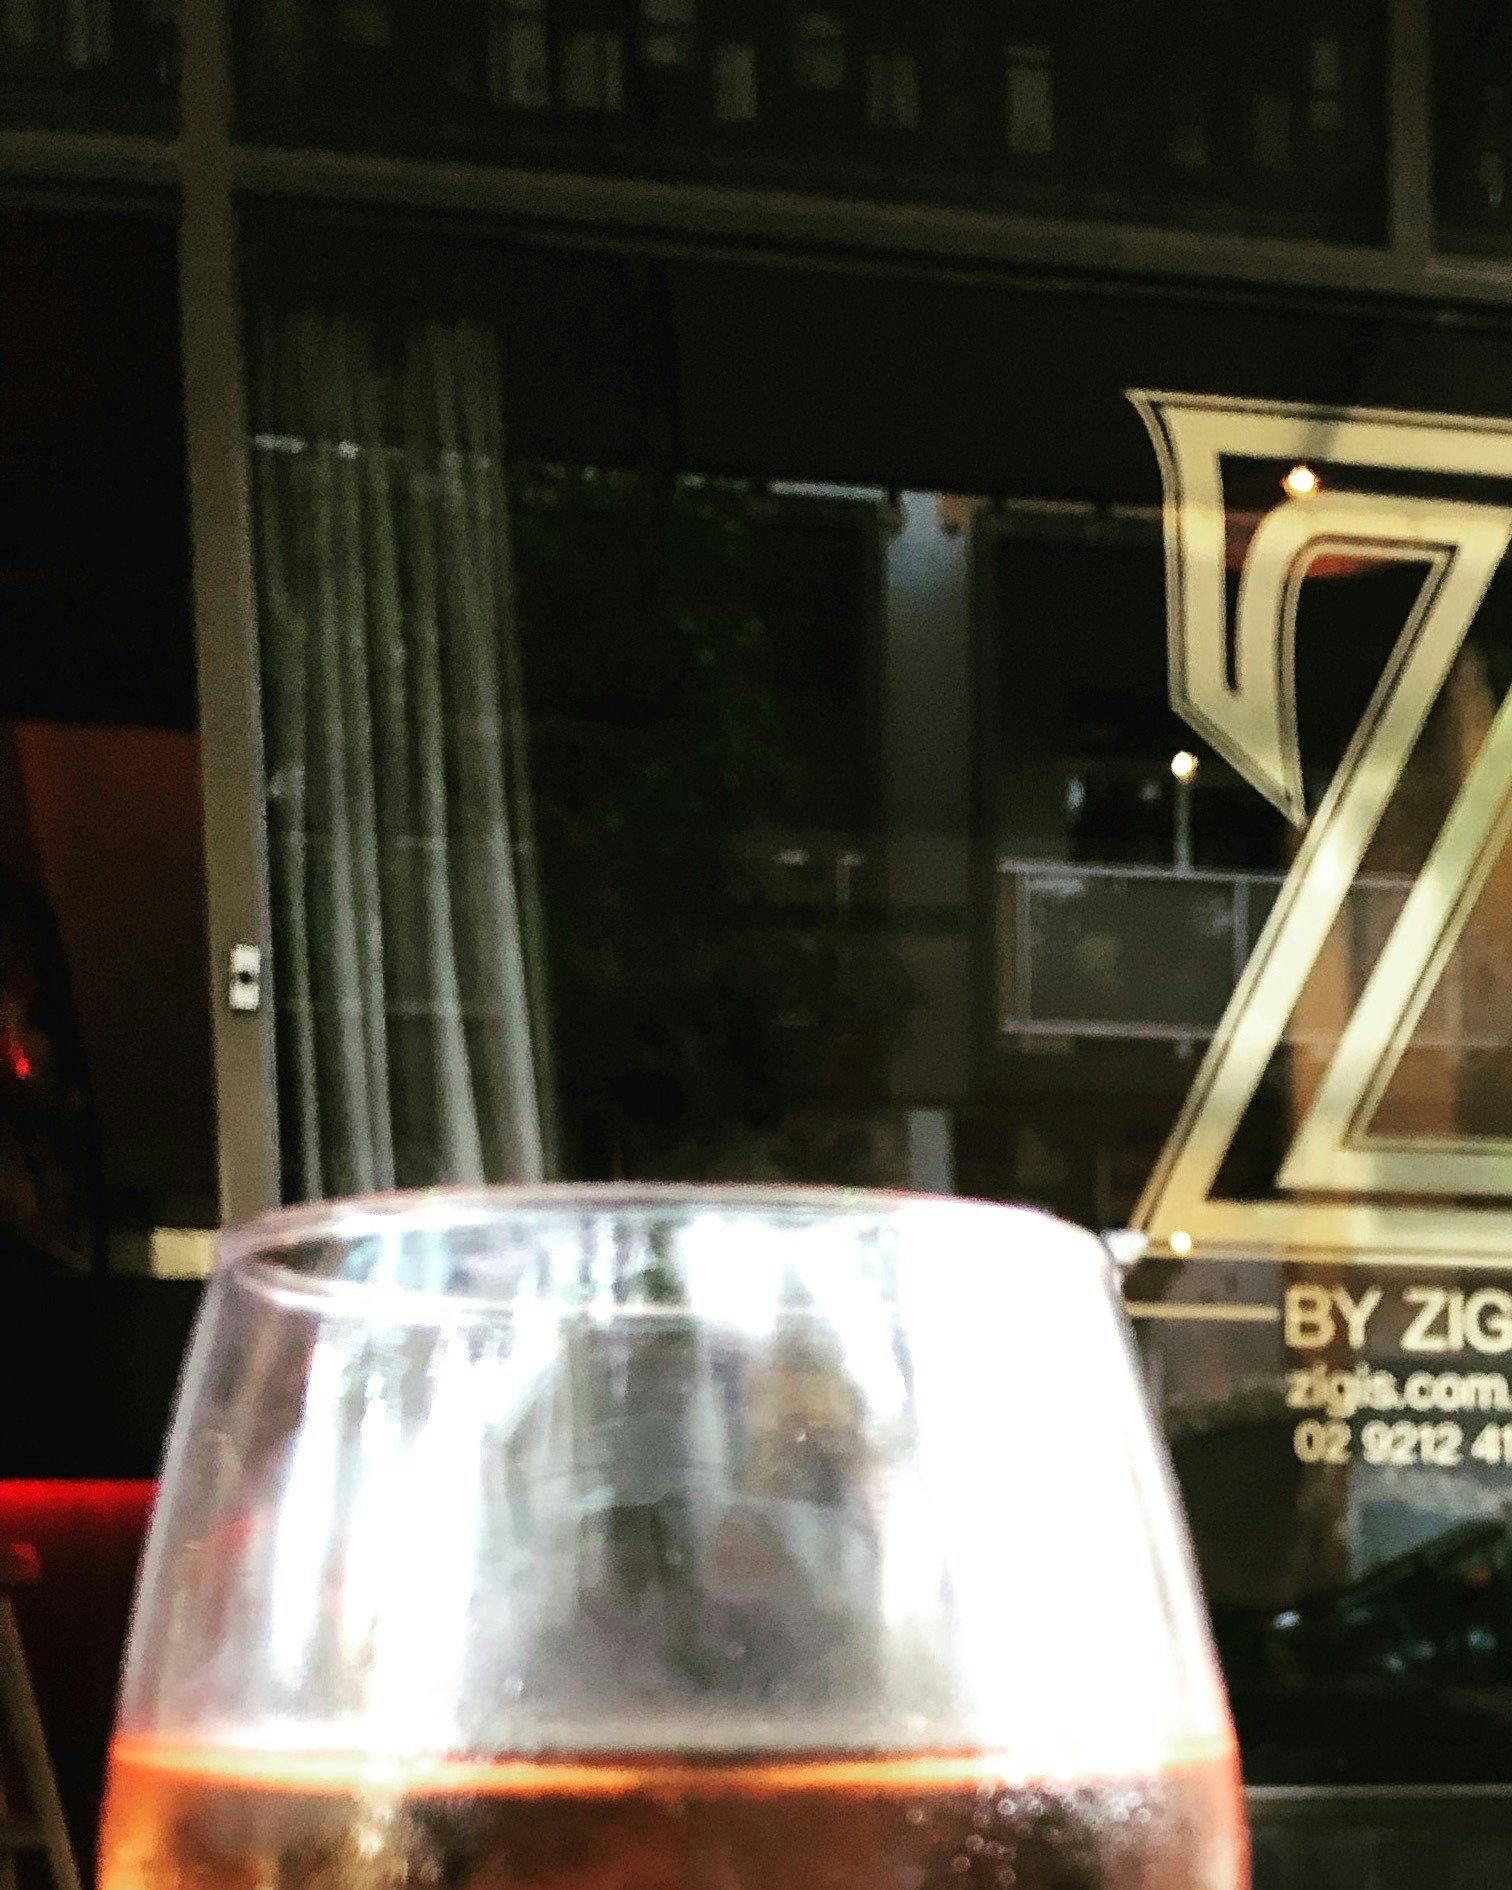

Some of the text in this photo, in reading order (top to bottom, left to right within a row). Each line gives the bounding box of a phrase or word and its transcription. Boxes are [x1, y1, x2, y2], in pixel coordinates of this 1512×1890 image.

[1285, 1284, 1381, 1351] BY
[1294, 1419, 1351, 1465] 02
[1361, 1420, 1463, 1466] 9212
